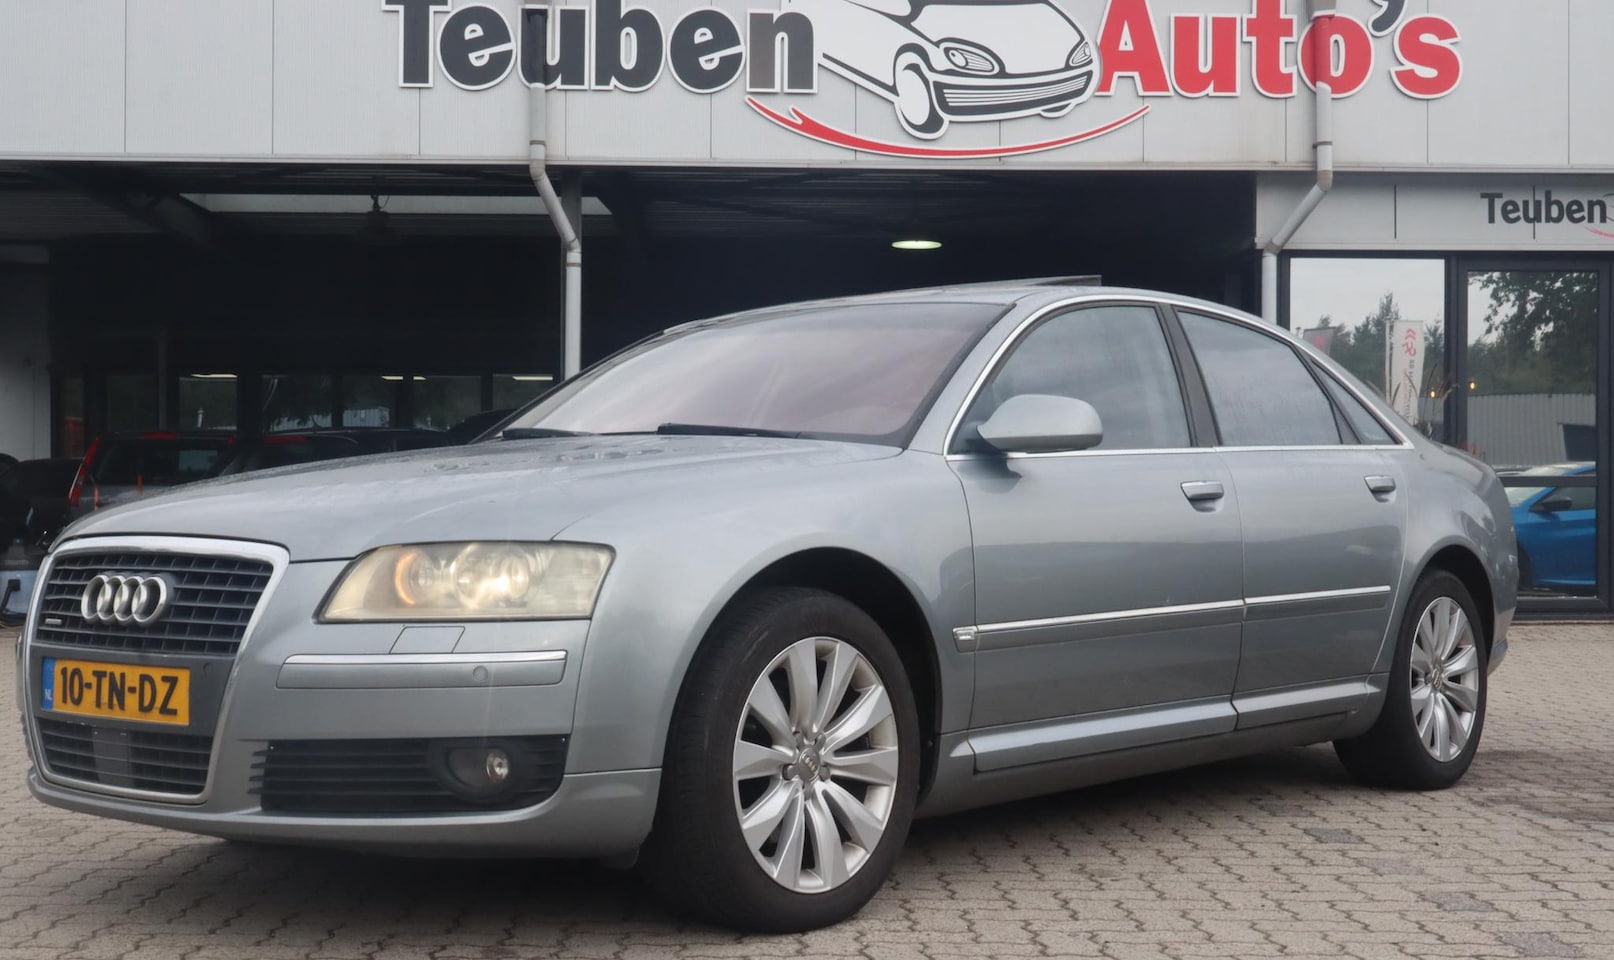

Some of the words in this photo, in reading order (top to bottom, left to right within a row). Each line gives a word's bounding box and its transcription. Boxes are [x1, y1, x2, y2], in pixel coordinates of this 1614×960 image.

[383, 0, 816, 92] Teuben
[1097, 0, 1463, 98] Auto's
[1480, 189, 1607, 224] Teuben
[60, 666, 179, 716] 10-TN-DZ
